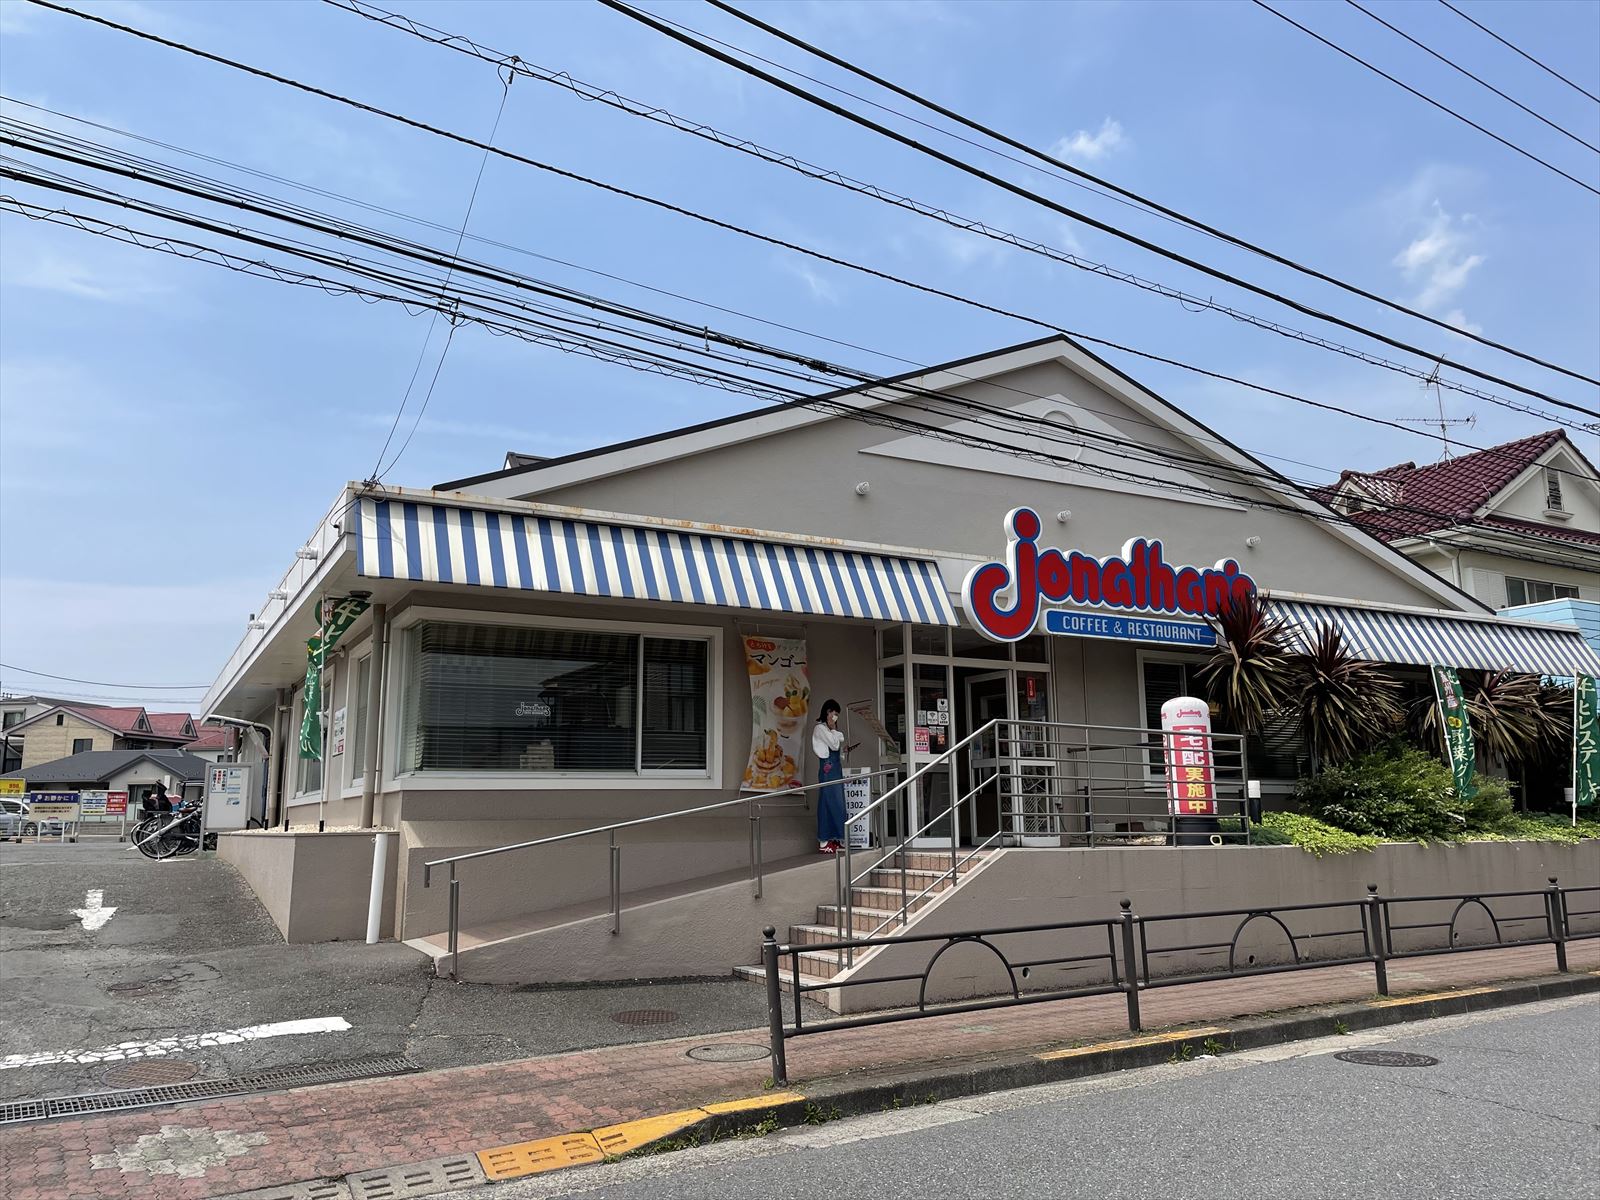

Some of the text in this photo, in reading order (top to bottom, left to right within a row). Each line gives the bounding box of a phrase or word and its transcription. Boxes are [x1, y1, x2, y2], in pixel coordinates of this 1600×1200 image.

[1062, 615, 1202, 642] COFFEE & RESTAURANT
[750, 654, 806, 668] マンゴー
[916, 733, 928, 742] Eat
[1180, 727, 1208, 814] 宅配実施中
